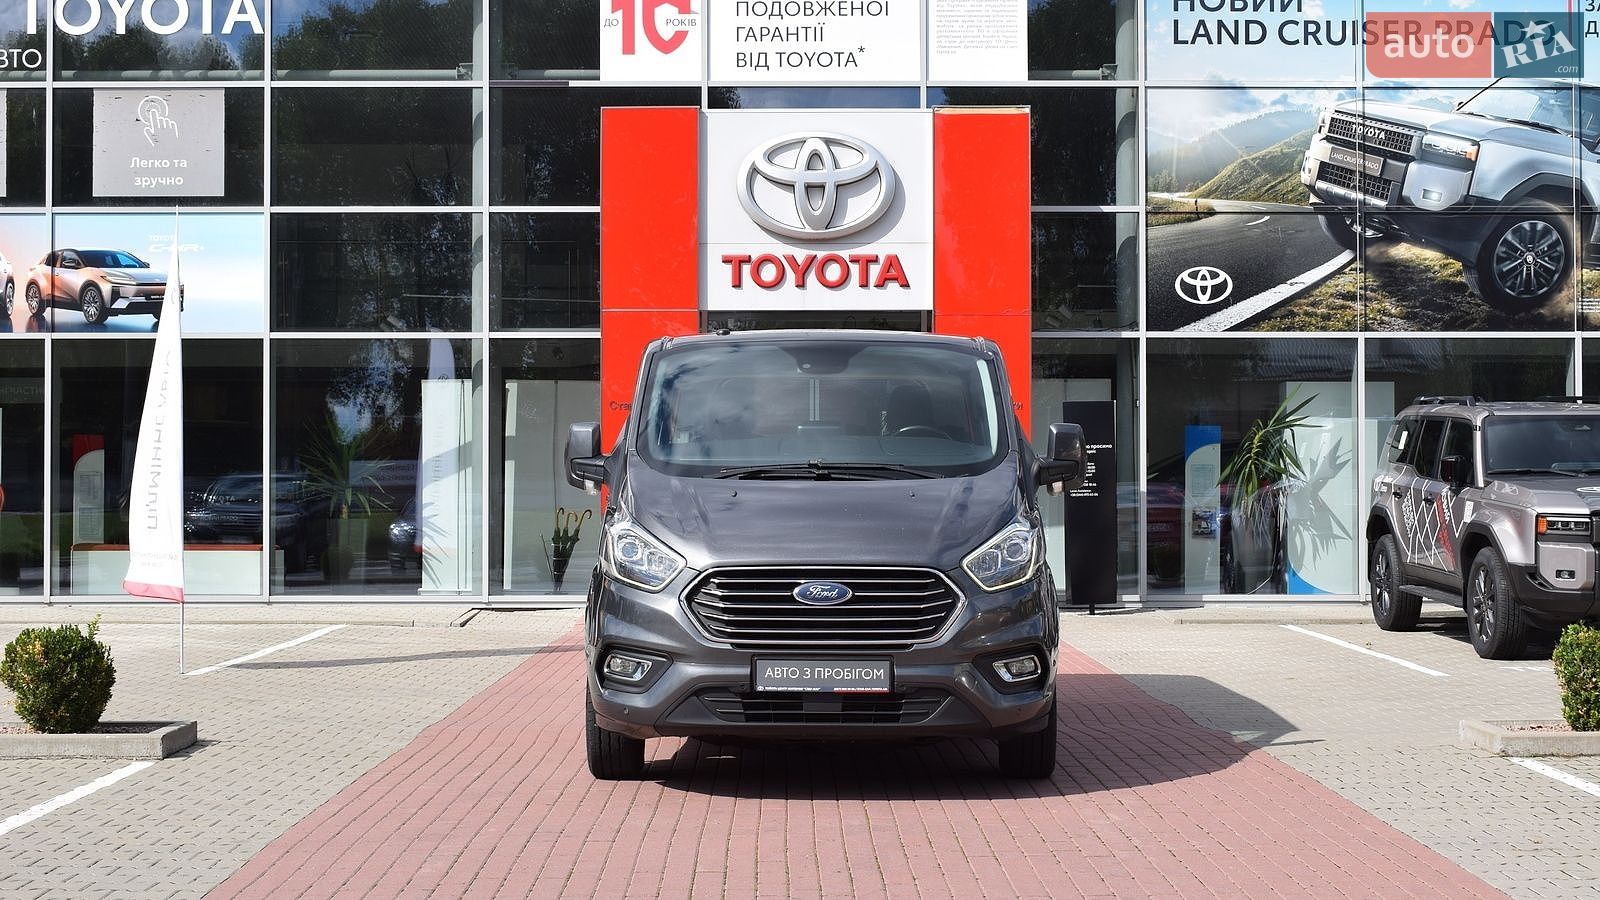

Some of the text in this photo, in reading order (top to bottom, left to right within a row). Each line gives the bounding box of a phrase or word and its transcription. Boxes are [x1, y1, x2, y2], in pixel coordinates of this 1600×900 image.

[603, 18, 620, 28] ДО
[665, 18, 697, 27] РОКІВ
[736, 22, 826, 42] ГАРАНТІЇ
[1173, 19, 1556, 46] LAND CRUISER PRADO
[736, 52, 770, 71] ВІД
[1352, 124, 1386, 140] TOYOTA
[129, 157, 188, 168] Легко та
[133, 175, 184, 188] зручно
[721, 253, 910, 289] TOYOTA
[806, 584, 839, 598] Ford
[764, 666, 800, 679] АВТО
[814, 667, 884, 680] ПРОБІГОМ
